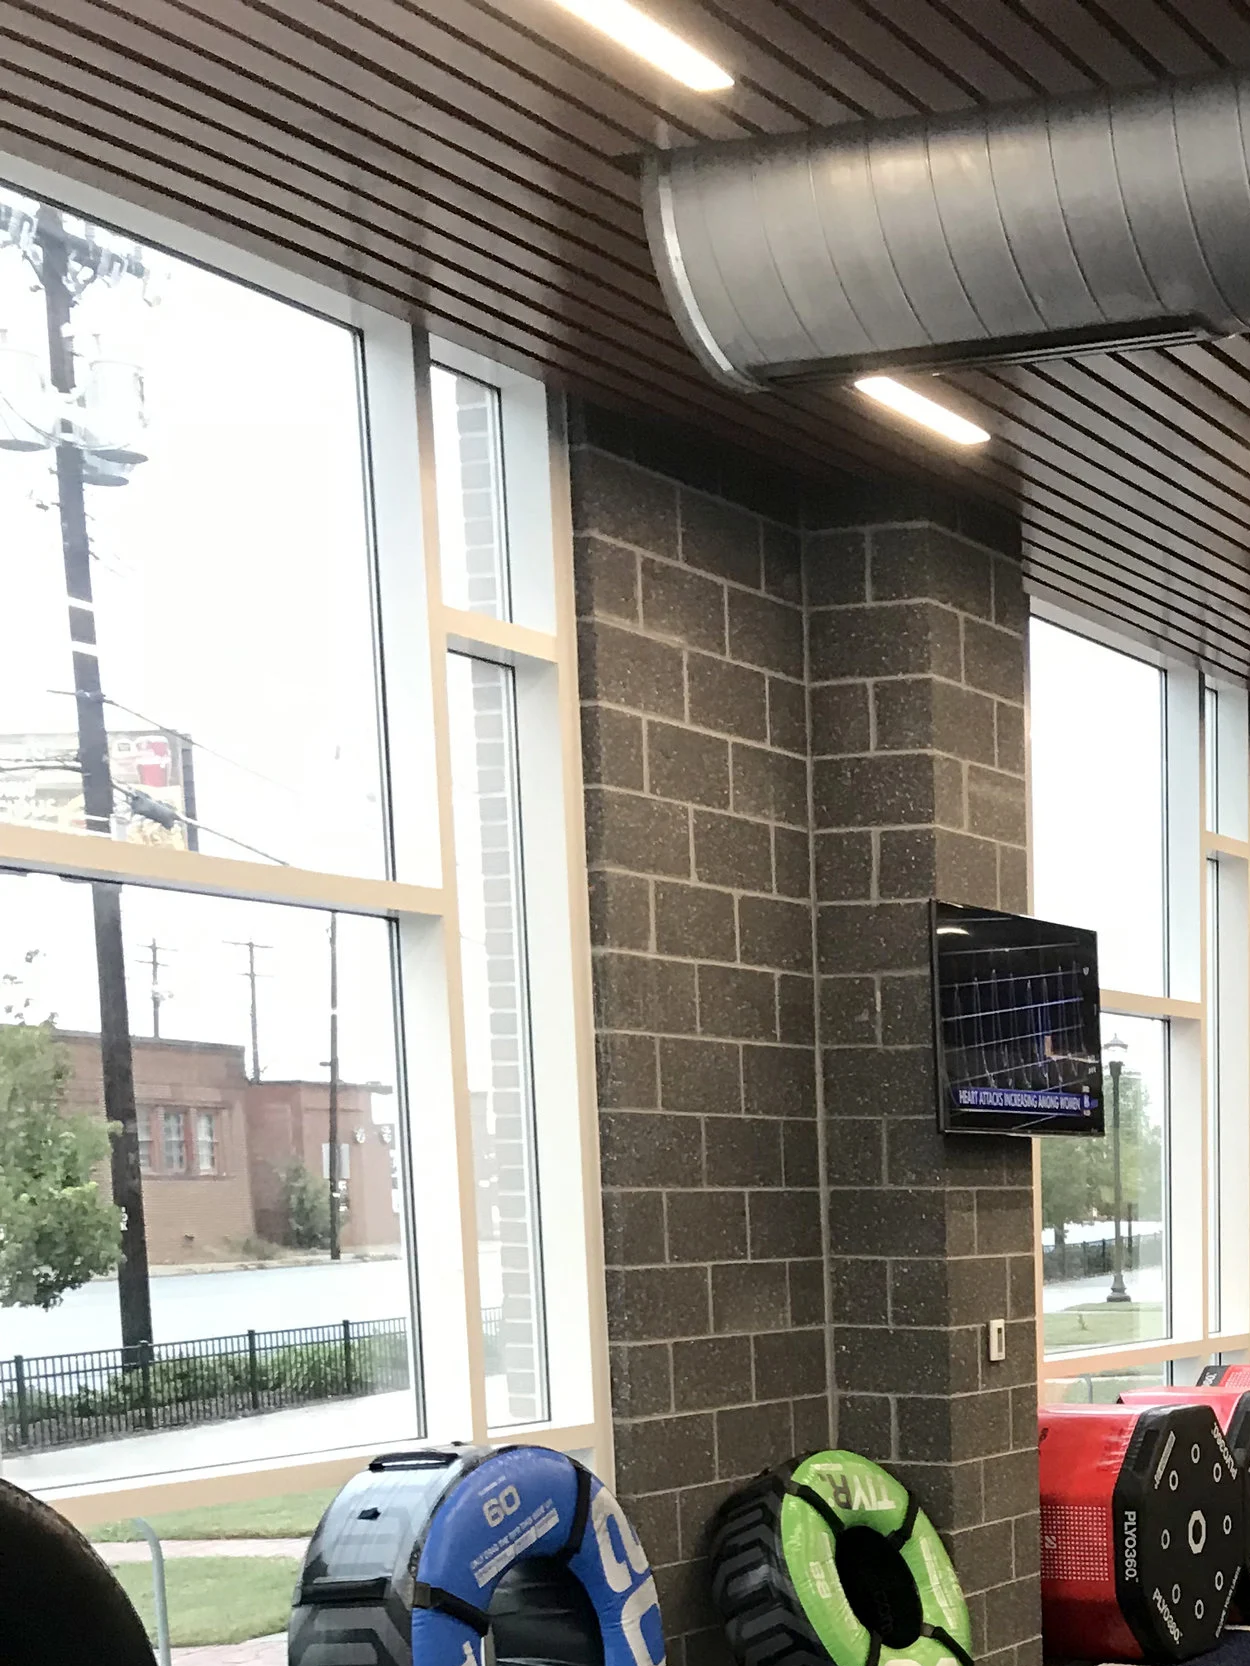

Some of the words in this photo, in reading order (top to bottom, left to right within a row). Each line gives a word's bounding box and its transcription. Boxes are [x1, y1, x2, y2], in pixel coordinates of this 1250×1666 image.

[959, 1090, 978, 1105] HEART
[979, 1091, 1003, 1107] ATTACKS
[1004, 1092, 1038, 1109] INCREASING
[1039, 1094, 1059, 1110] AMONG
[1060, 1095, 1081, 1111] WOMEN
[482, 1484, 521, 1528] 60
